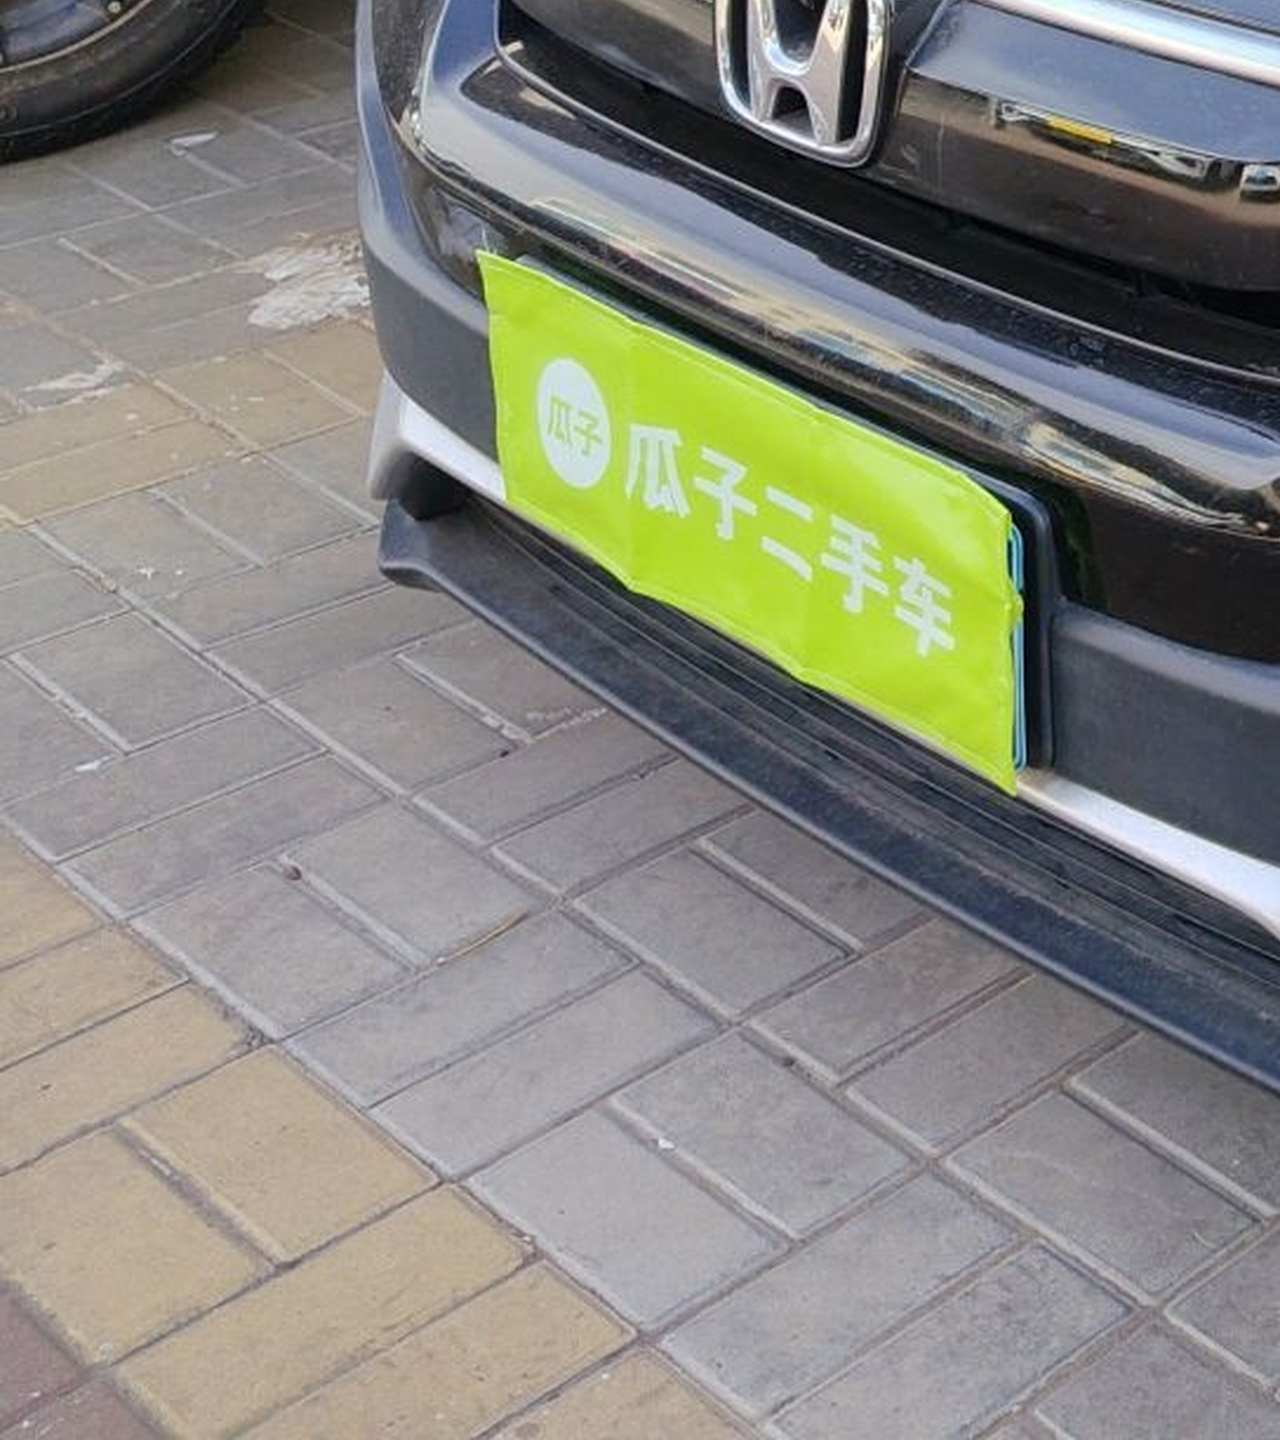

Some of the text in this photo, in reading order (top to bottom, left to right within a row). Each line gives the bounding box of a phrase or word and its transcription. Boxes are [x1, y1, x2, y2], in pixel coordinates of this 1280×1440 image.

[547, 396, 603, 456] 瓜子
[624, 422, 955, 656] 瓜子二手车
